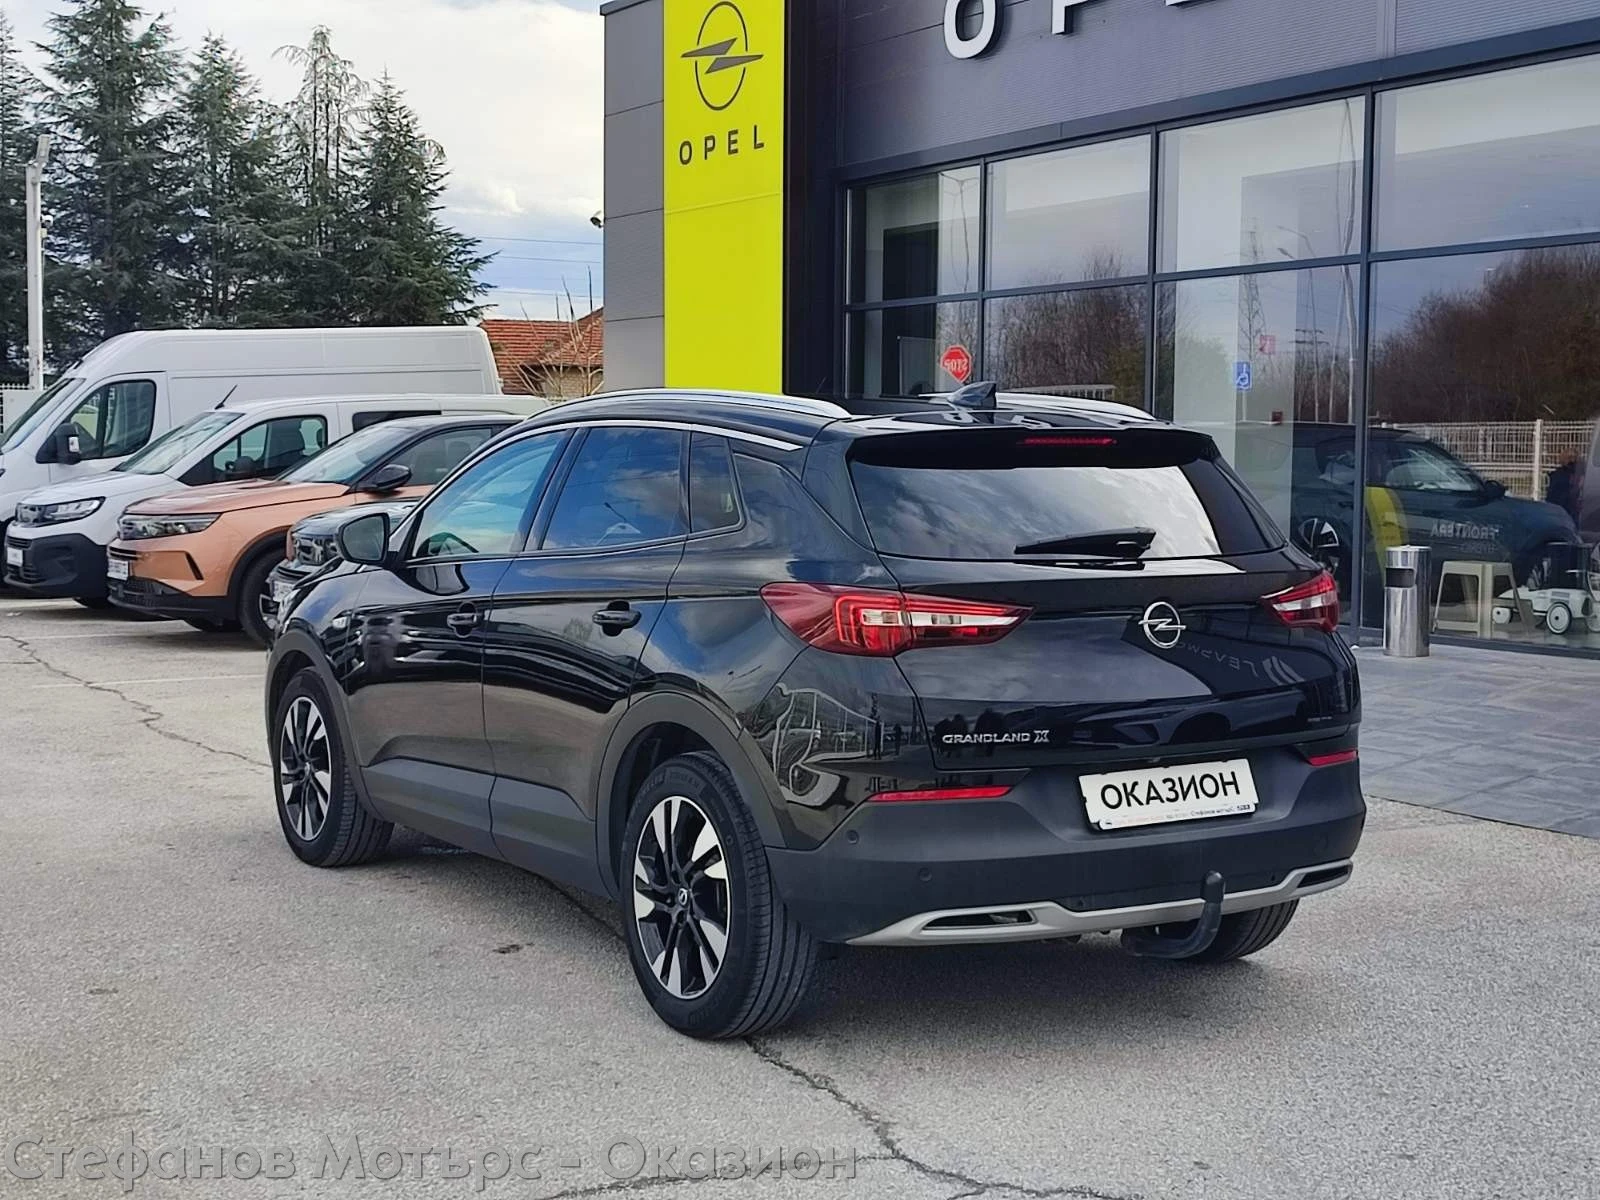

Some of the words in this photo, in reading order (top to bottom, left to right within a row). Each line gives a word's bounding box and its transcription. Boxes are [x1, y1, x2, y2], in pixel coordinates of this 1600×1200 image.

[679, 124, 765, 166] OPEL
[942, 733, 1031, 743] GRANDLAND
[1033, 730, 1050, 743] X
[1100, 770, 1241, 809] ОКАЗИОН
